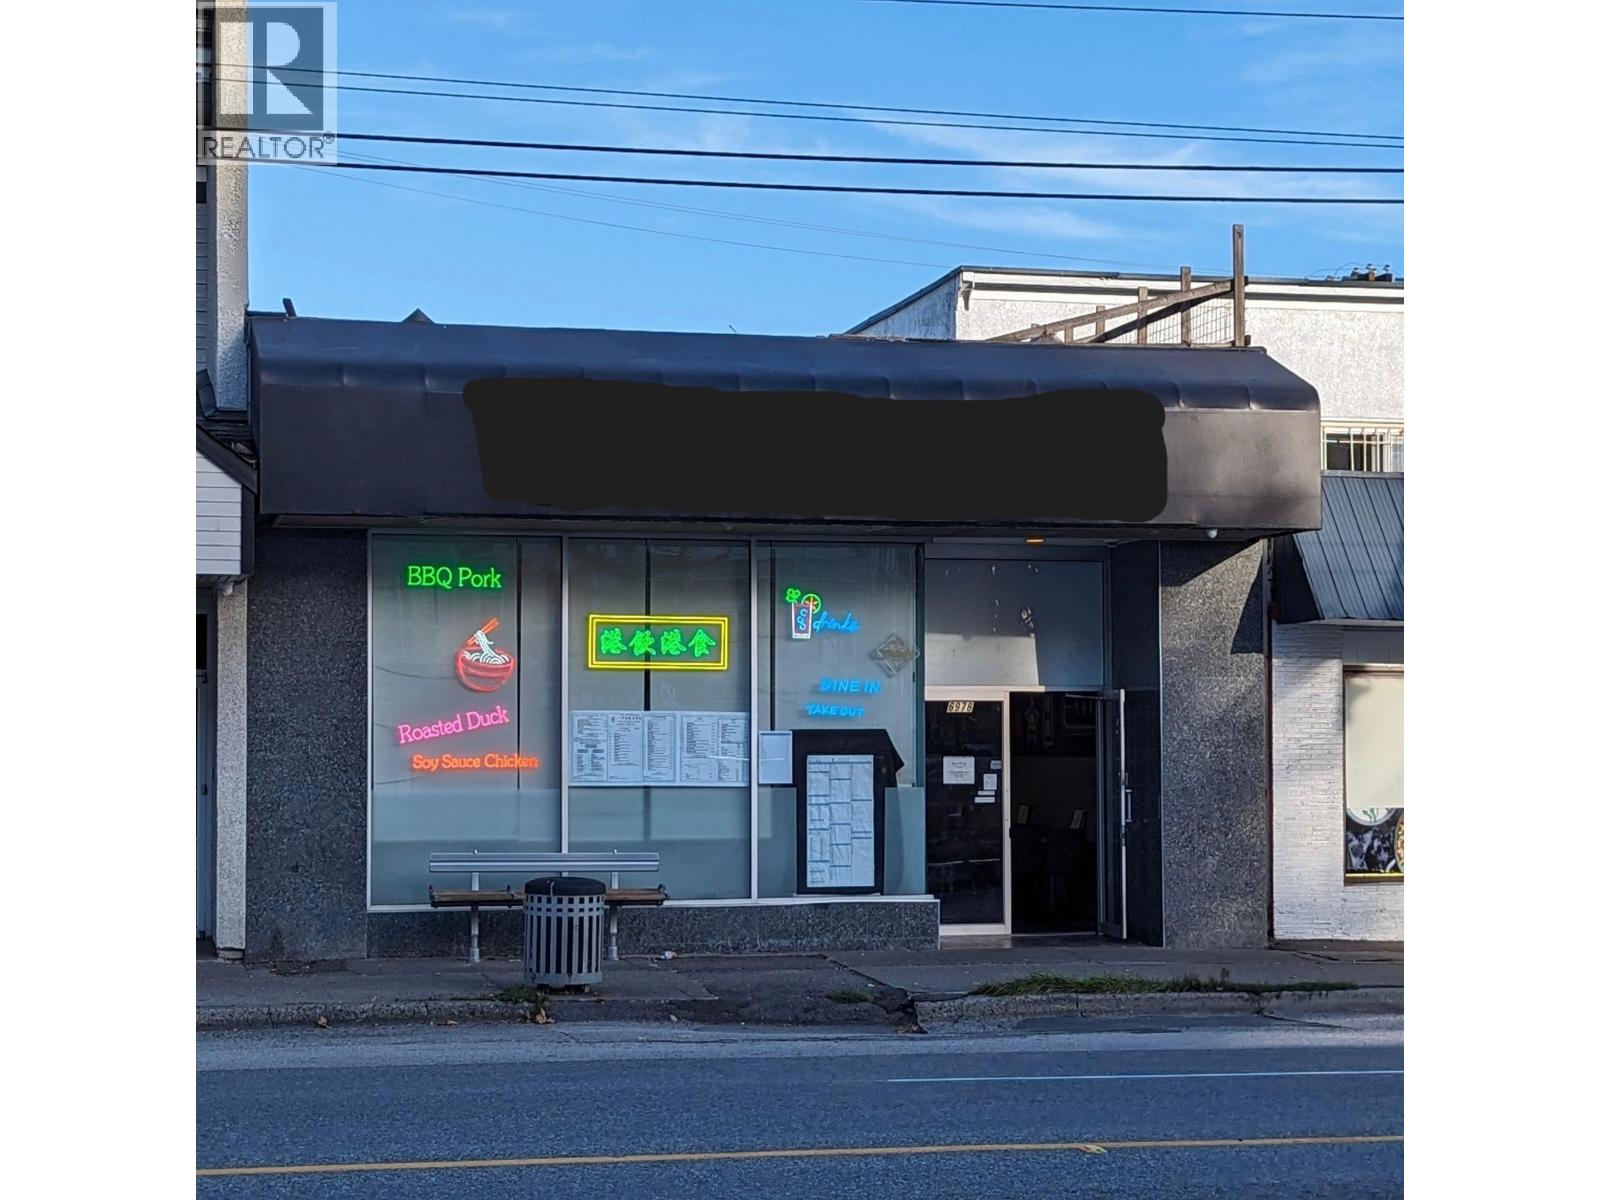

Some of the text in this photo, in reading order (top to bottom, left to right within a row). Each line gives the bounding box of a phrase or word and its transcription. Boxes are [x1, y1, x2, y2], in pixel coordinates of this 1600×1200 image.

[407, 566, 502, 589] BBQ Pork
[812, 611, 860, 633] drinks
[820, 678, 881, 694] DINE IN
[806, 704, 865, 717] TAKE OUT
[948, 701, 973, 712] 6978
[398, 705, 510, 744] Roasted Duck
[412, 753, 539, 772] Soy Sauce Chicken
